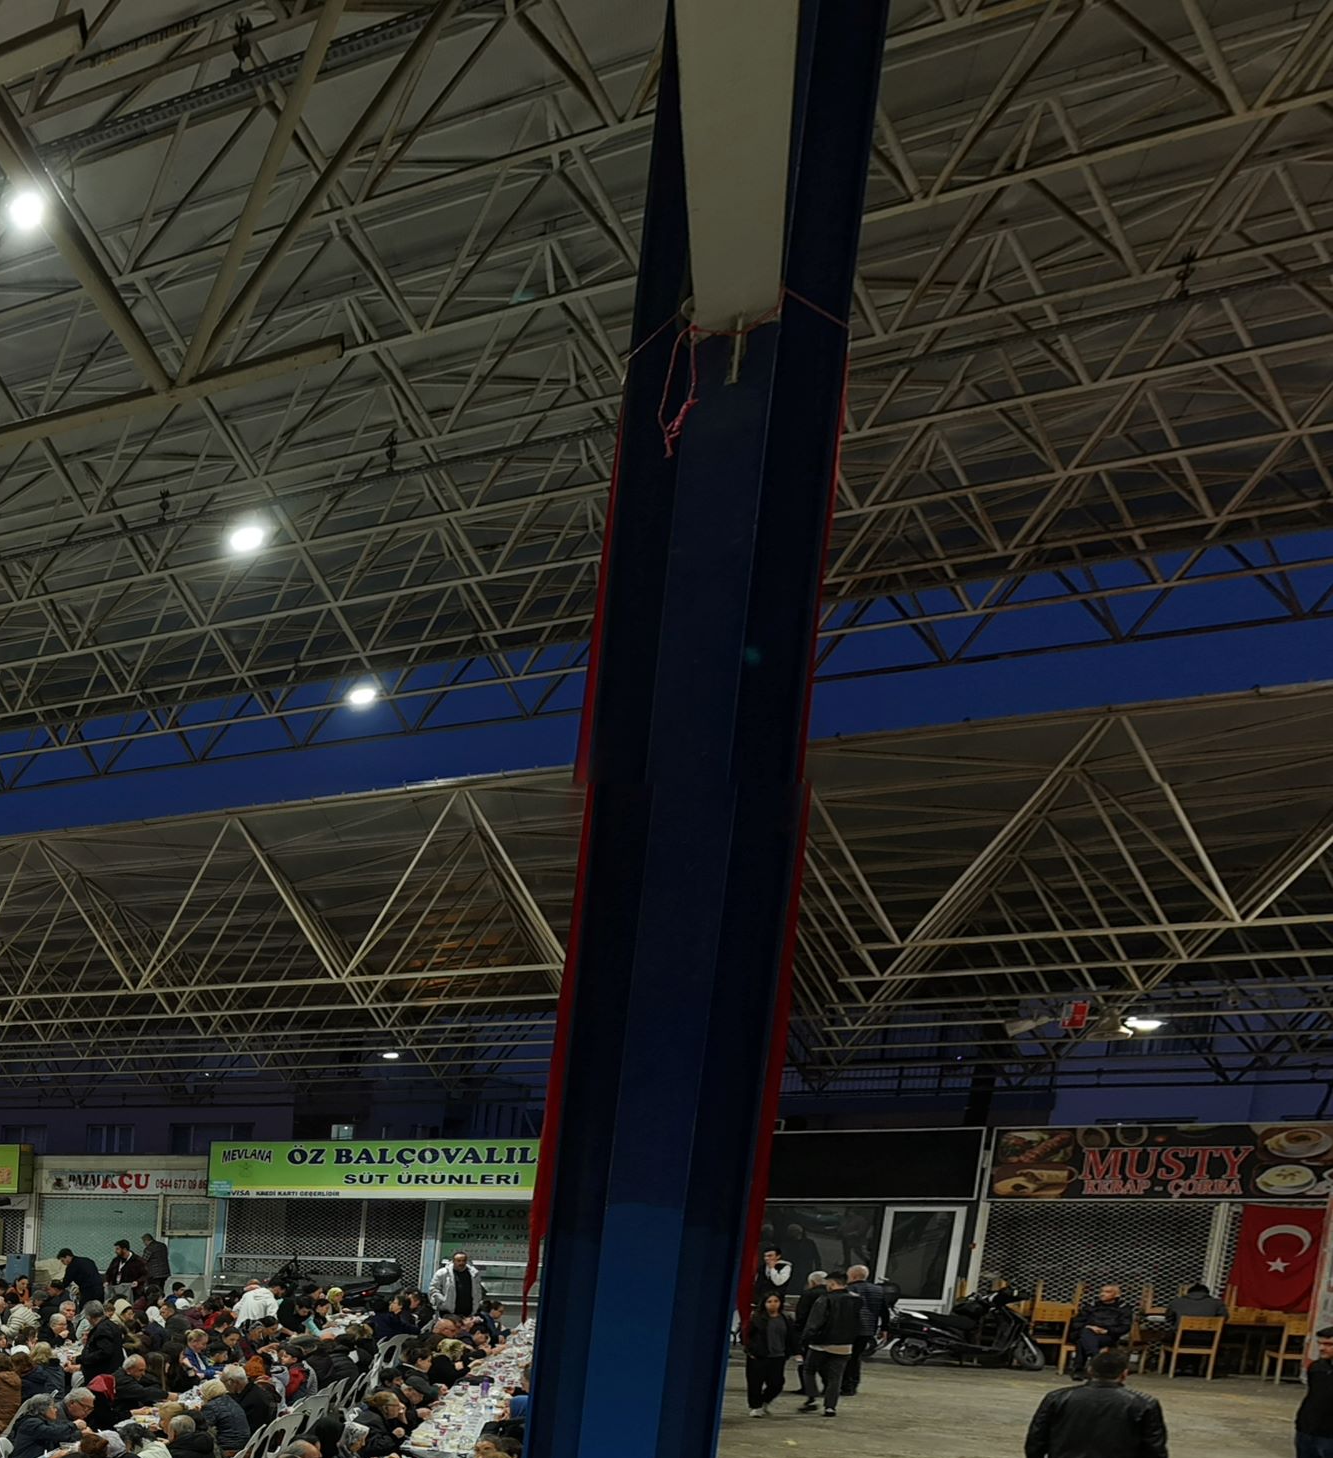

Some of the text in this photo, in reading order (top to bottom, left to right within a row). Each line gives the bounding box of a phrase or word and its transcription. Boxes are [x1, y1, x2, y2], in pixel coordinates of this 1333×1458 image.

[221, 1148, 272, 1163] MEVLANA
[287, 1144, 538, 1168] ÖZ BALÇOVALIL
[1079, 1146, 1254, 1180] MUSTY
[343, 1171, 520, 1185] SÜT ÜRÜNLERİ
[1083, 1179, 1151, 1195] KEBAP
[1168, 1179, 1243, 1199] ÇORBA
